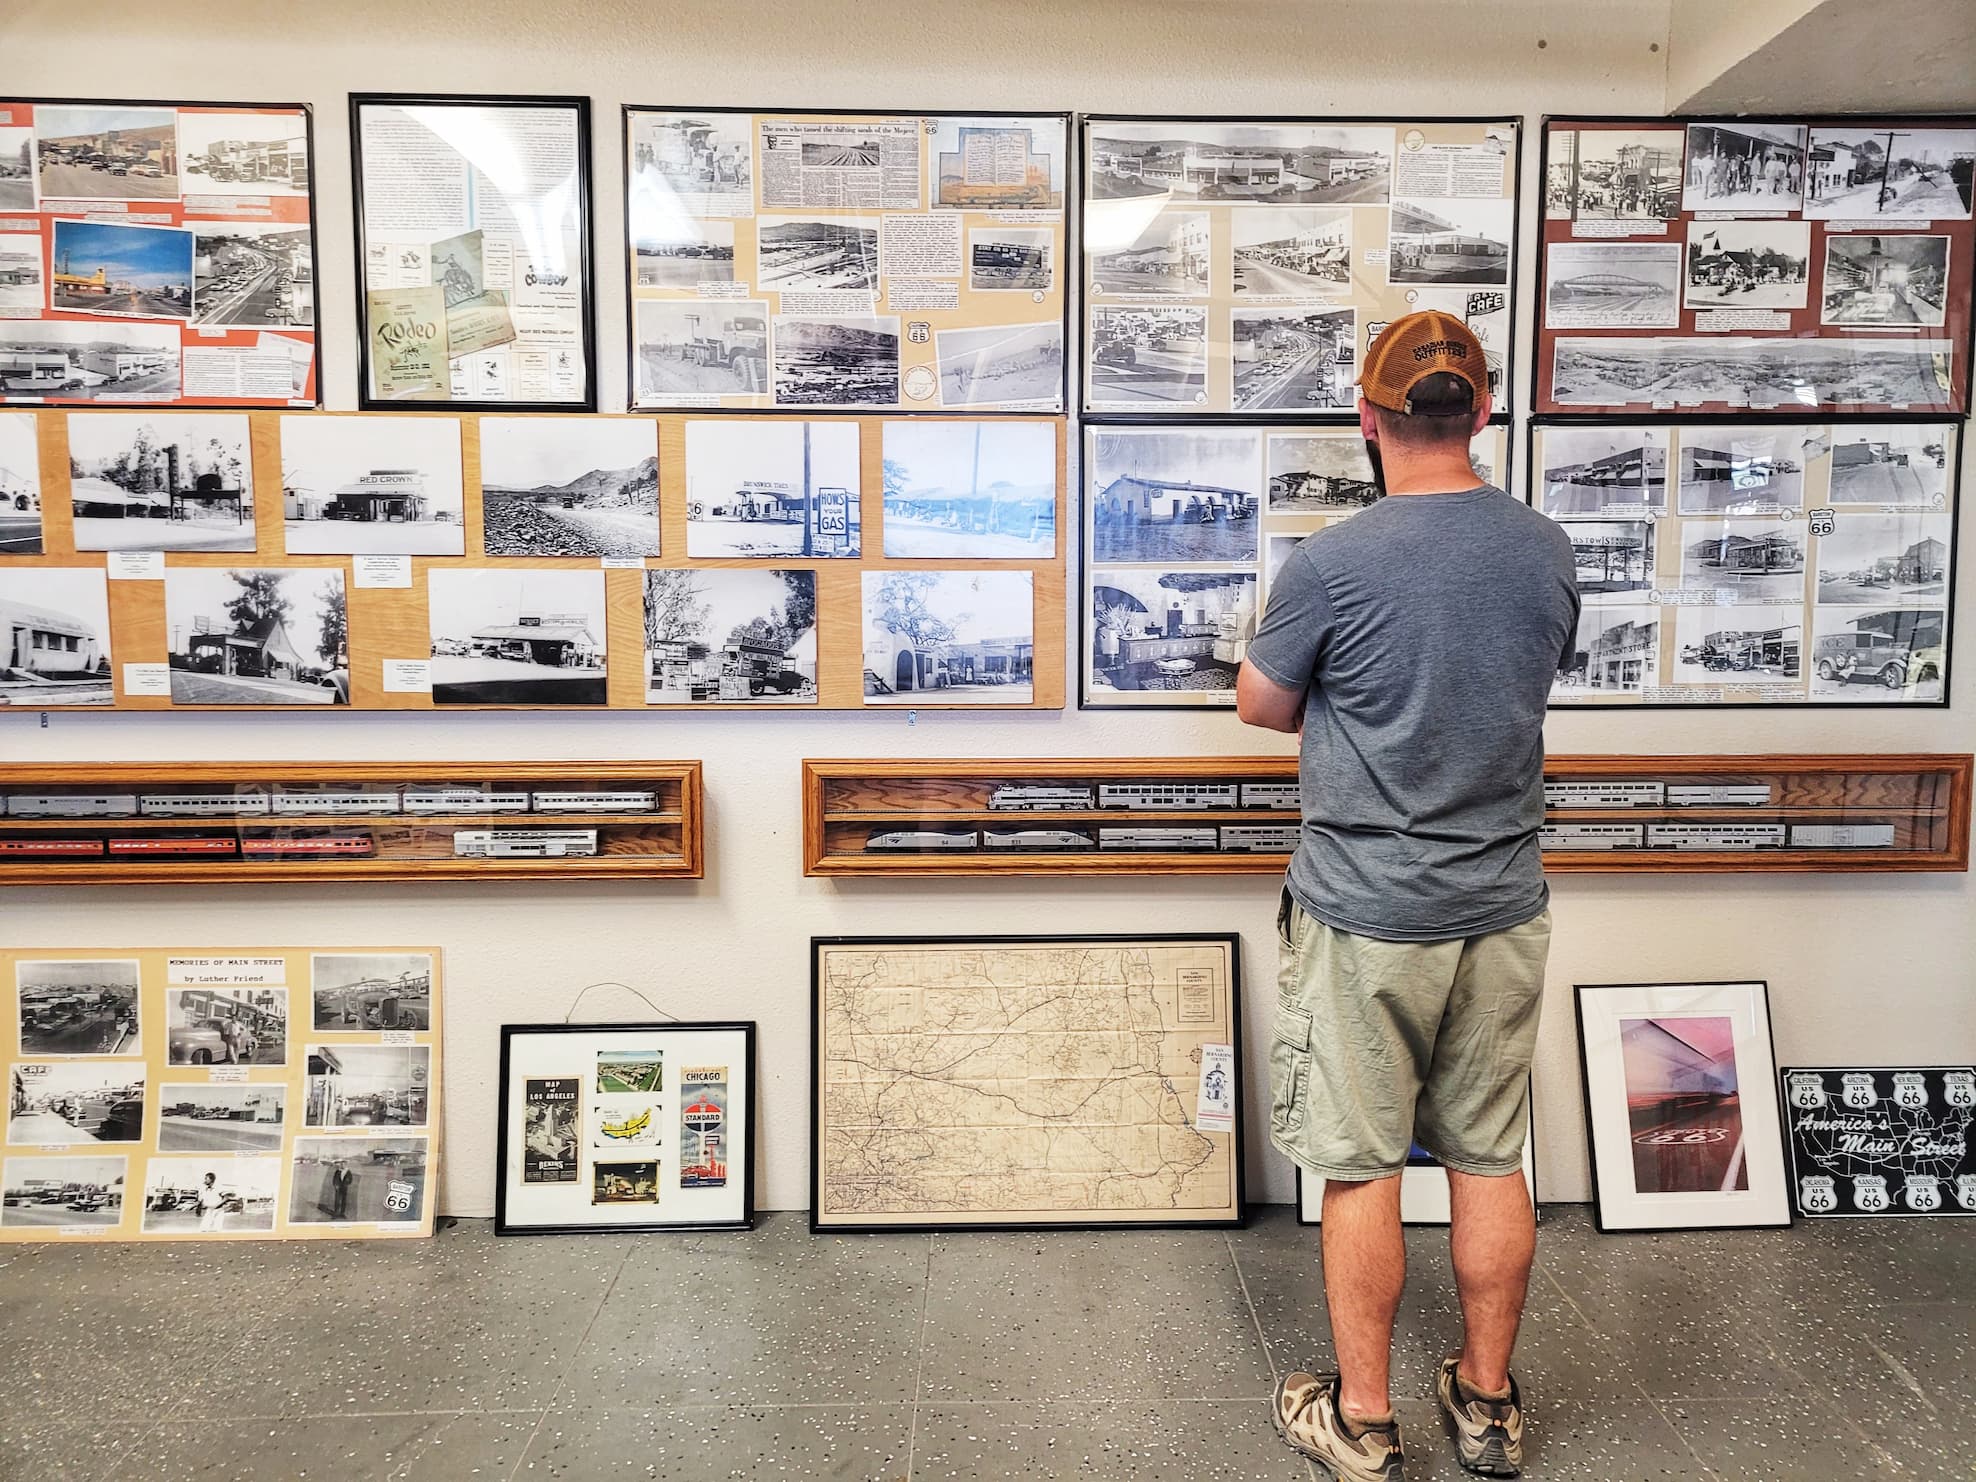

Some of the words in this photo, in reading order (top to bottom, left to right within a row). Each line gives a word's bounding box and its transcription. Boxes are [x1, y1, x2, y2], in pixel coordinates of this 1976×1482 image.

[834, 126, 856, 134] shifting
[1468, 294, 1501, 313] CAFE
[377, 317, 437, 350] Rodeo
[912, 332, 926, 341] 66
[821, 493, 845, 506] HOWS
[694, 502, 702, 515] 6
[821, 516, 845, 530] GAS
[1811, 522, 1832, 534] 66
[1822, 637, 1845, 648] ICE
[686, 1072, 721, 1081] CHICAGO
[1800, 1093, 1818, 1105] 66
[1851, 1093, 1870, 1105] 66
[1902, 1092, 1921, 1104] 66
[1953, 1091, 1971, 1104] 66
[1795, 1113, 1890, 1132] America's
[1650, 1133, 1707, 1142] 66
[1838, 1134, 1896, 1153] Main
[1910, 1137, 1967, 1156] Street
[387, 1195, 408, 1209] 66
[1810, 1195, 1829, 1207] 66
[1862, 1195, 1881, 1207] 66
[1915, 1194, 1933, 1206] 66
